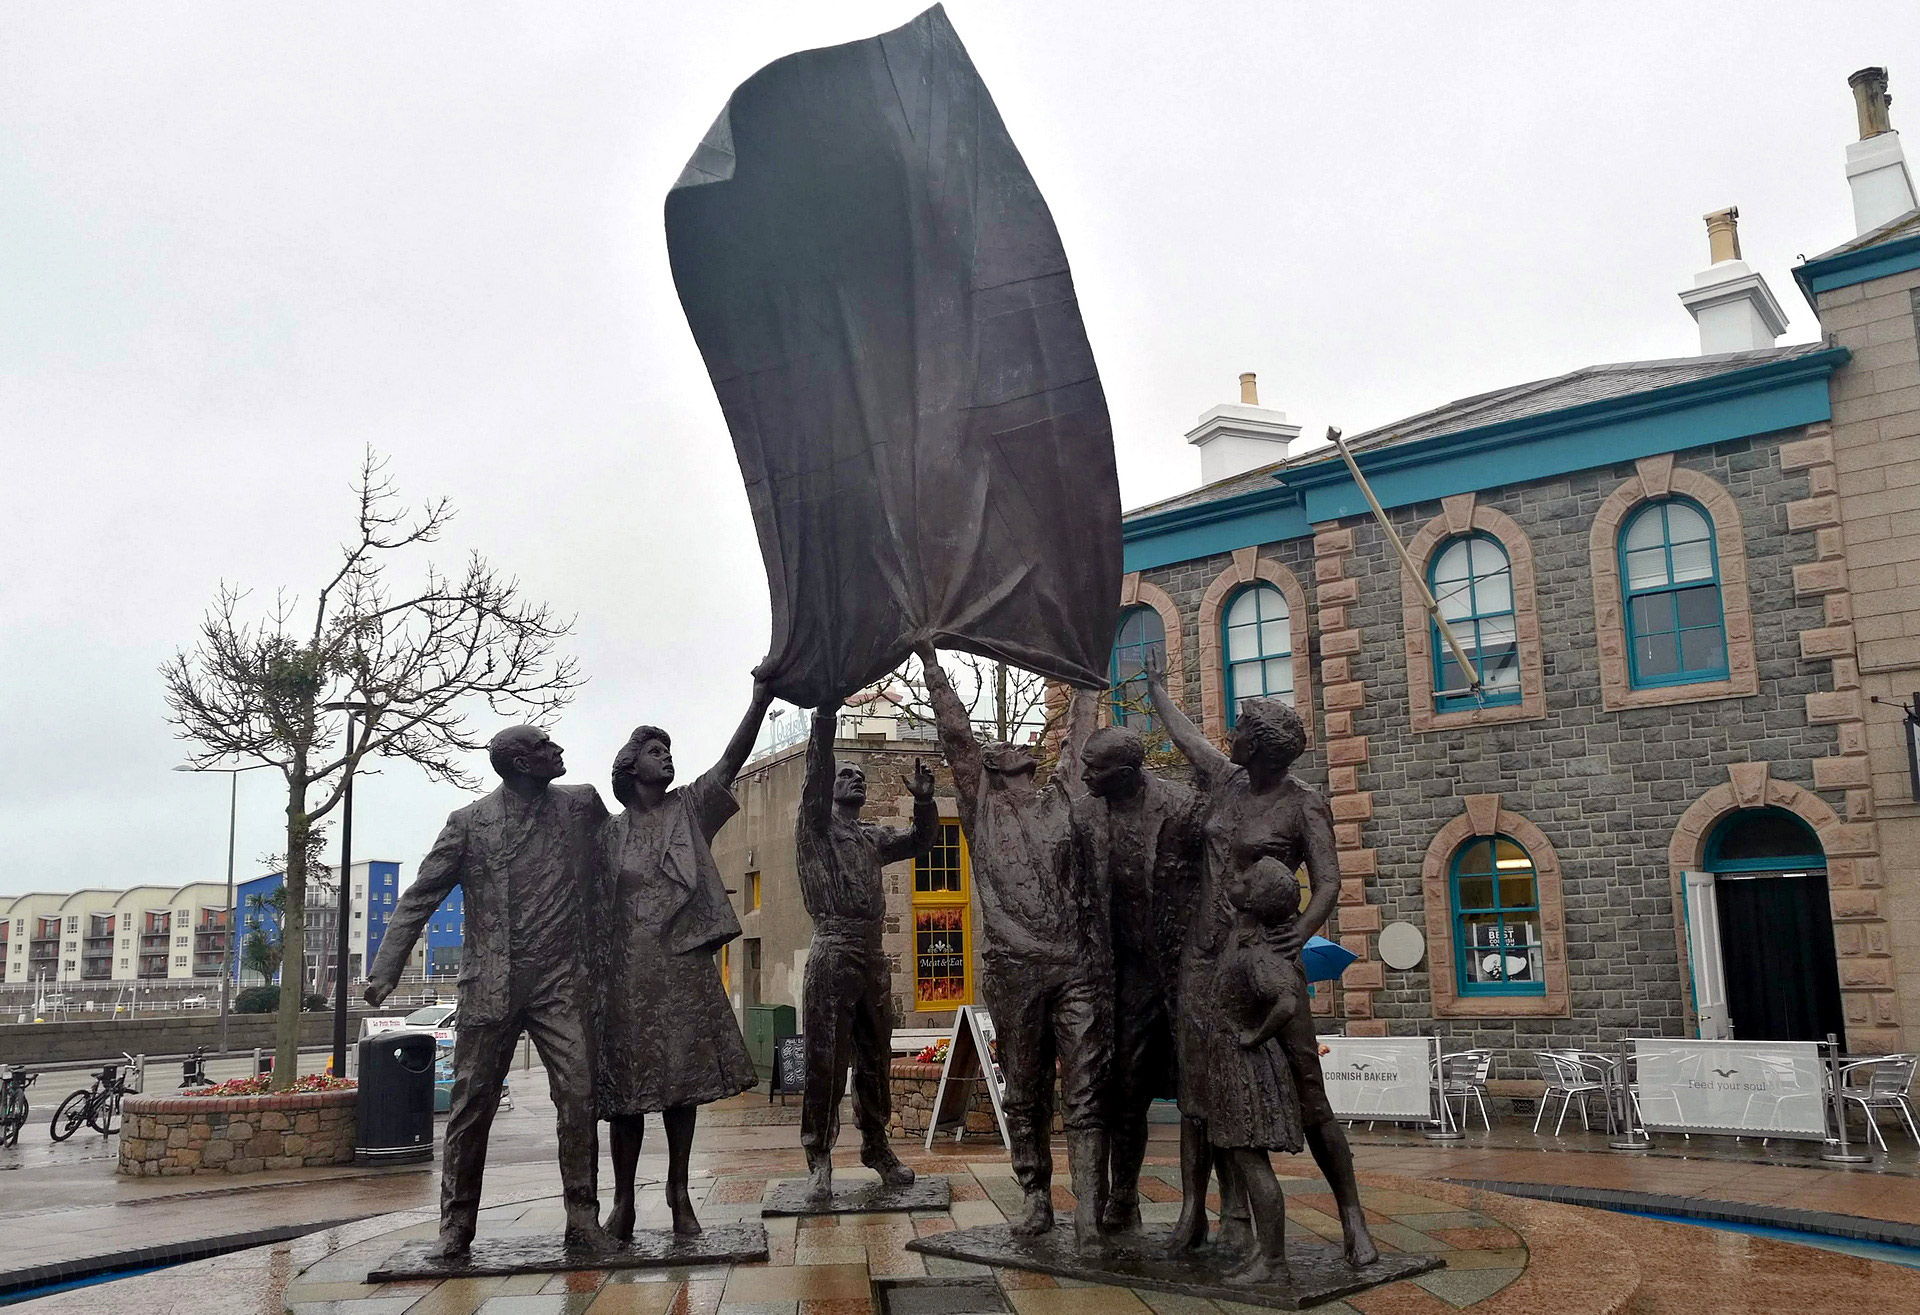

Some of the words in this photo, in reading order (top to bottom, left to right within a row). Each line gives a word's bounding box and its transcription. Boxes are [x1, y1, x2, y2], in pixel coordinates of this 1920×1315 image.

[1489, 930, 1514, 939] BEST
[950, 958, 963, 967] Eat
[1325, 1072, 1362, 1081] CORNISH
[1364, 1072, 1398, 1081] BAKERY
[1688, 1080, 1714, 1089] Feed
[1717, 1081, 1741, 1091] your
[1743, 1082, 1766, 1091] soul
